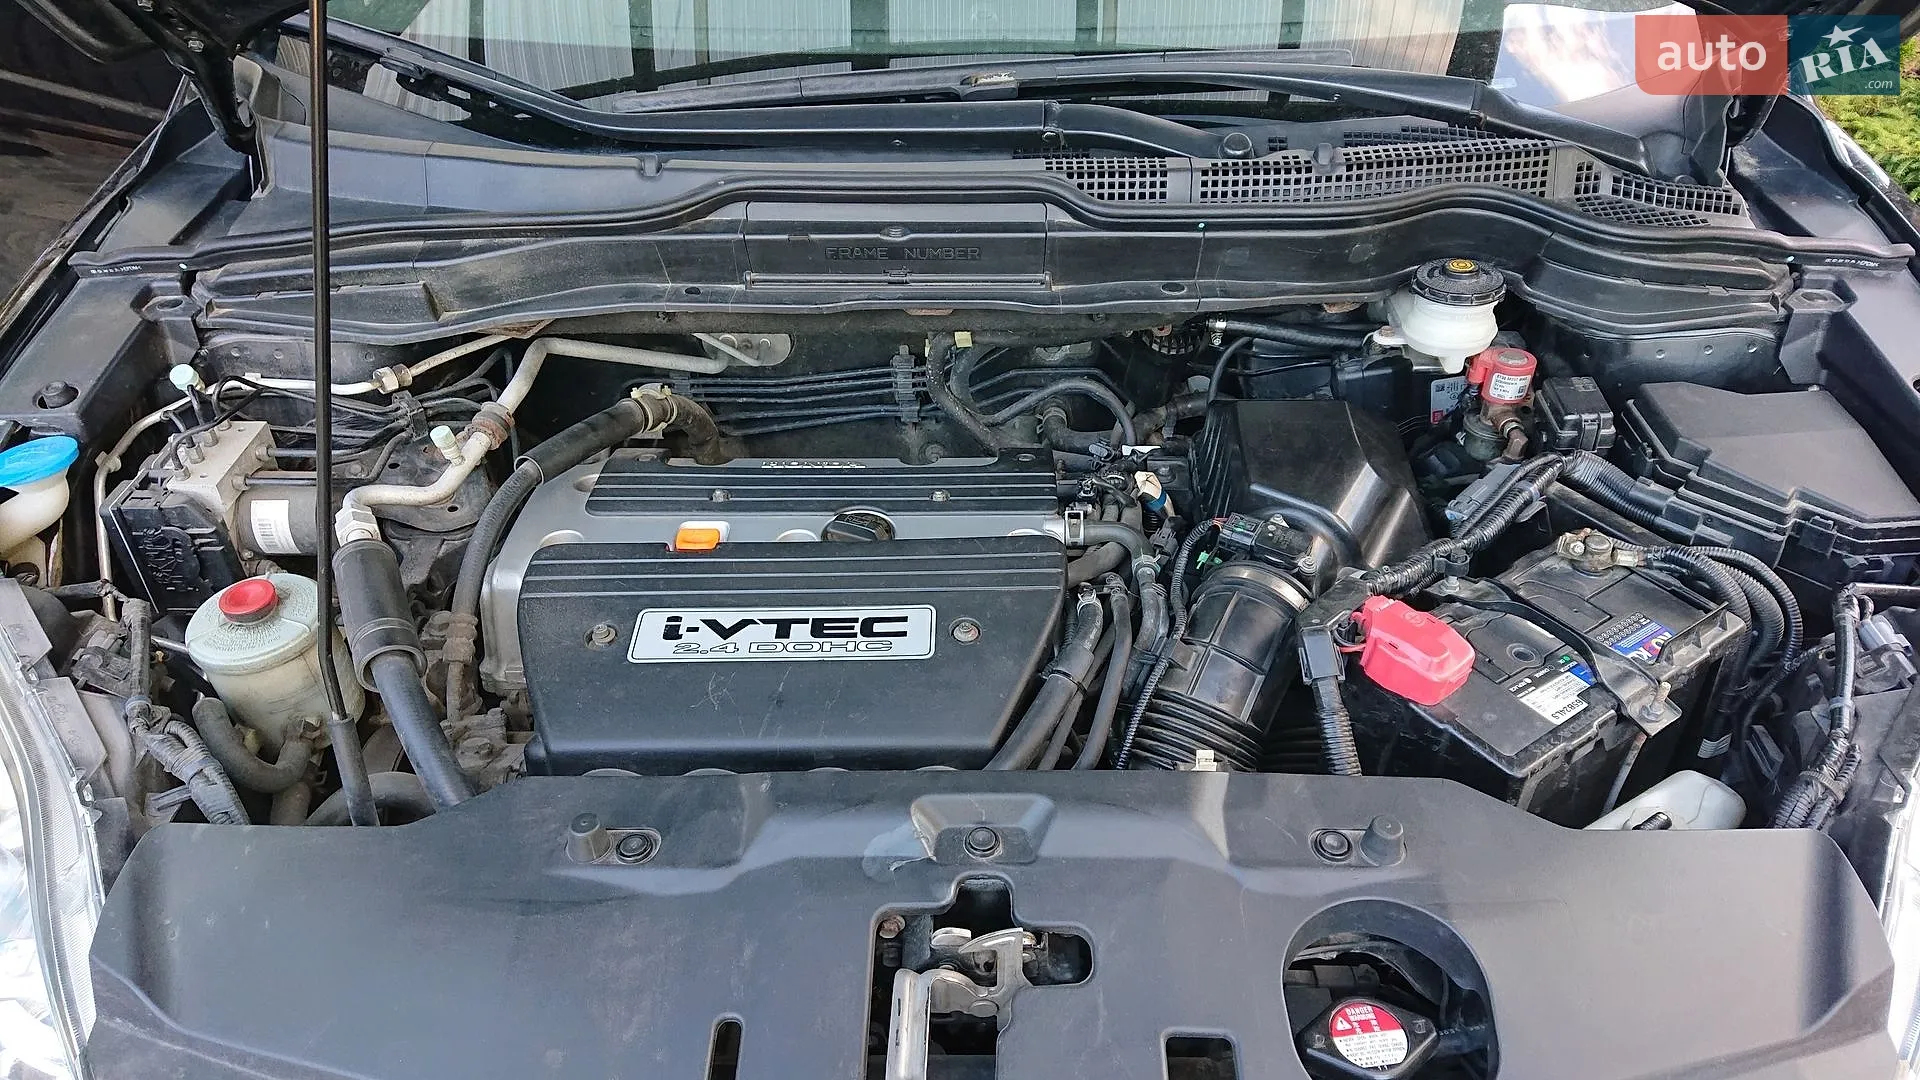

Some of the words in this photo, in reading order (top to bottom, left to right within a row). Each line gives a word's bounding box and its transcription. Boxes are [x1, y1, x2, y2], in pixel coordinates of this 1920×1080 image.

[825, 247, 889, 260] FRAME
[904, 247, 982, 260] NUMBER
[662, 615, 909, 641] i-VTEC
[673, 642, 739, 655] 2.4
[748, 640, 893, 654] DOHC
[1345, 1006, 1373, 1016] DANGER
